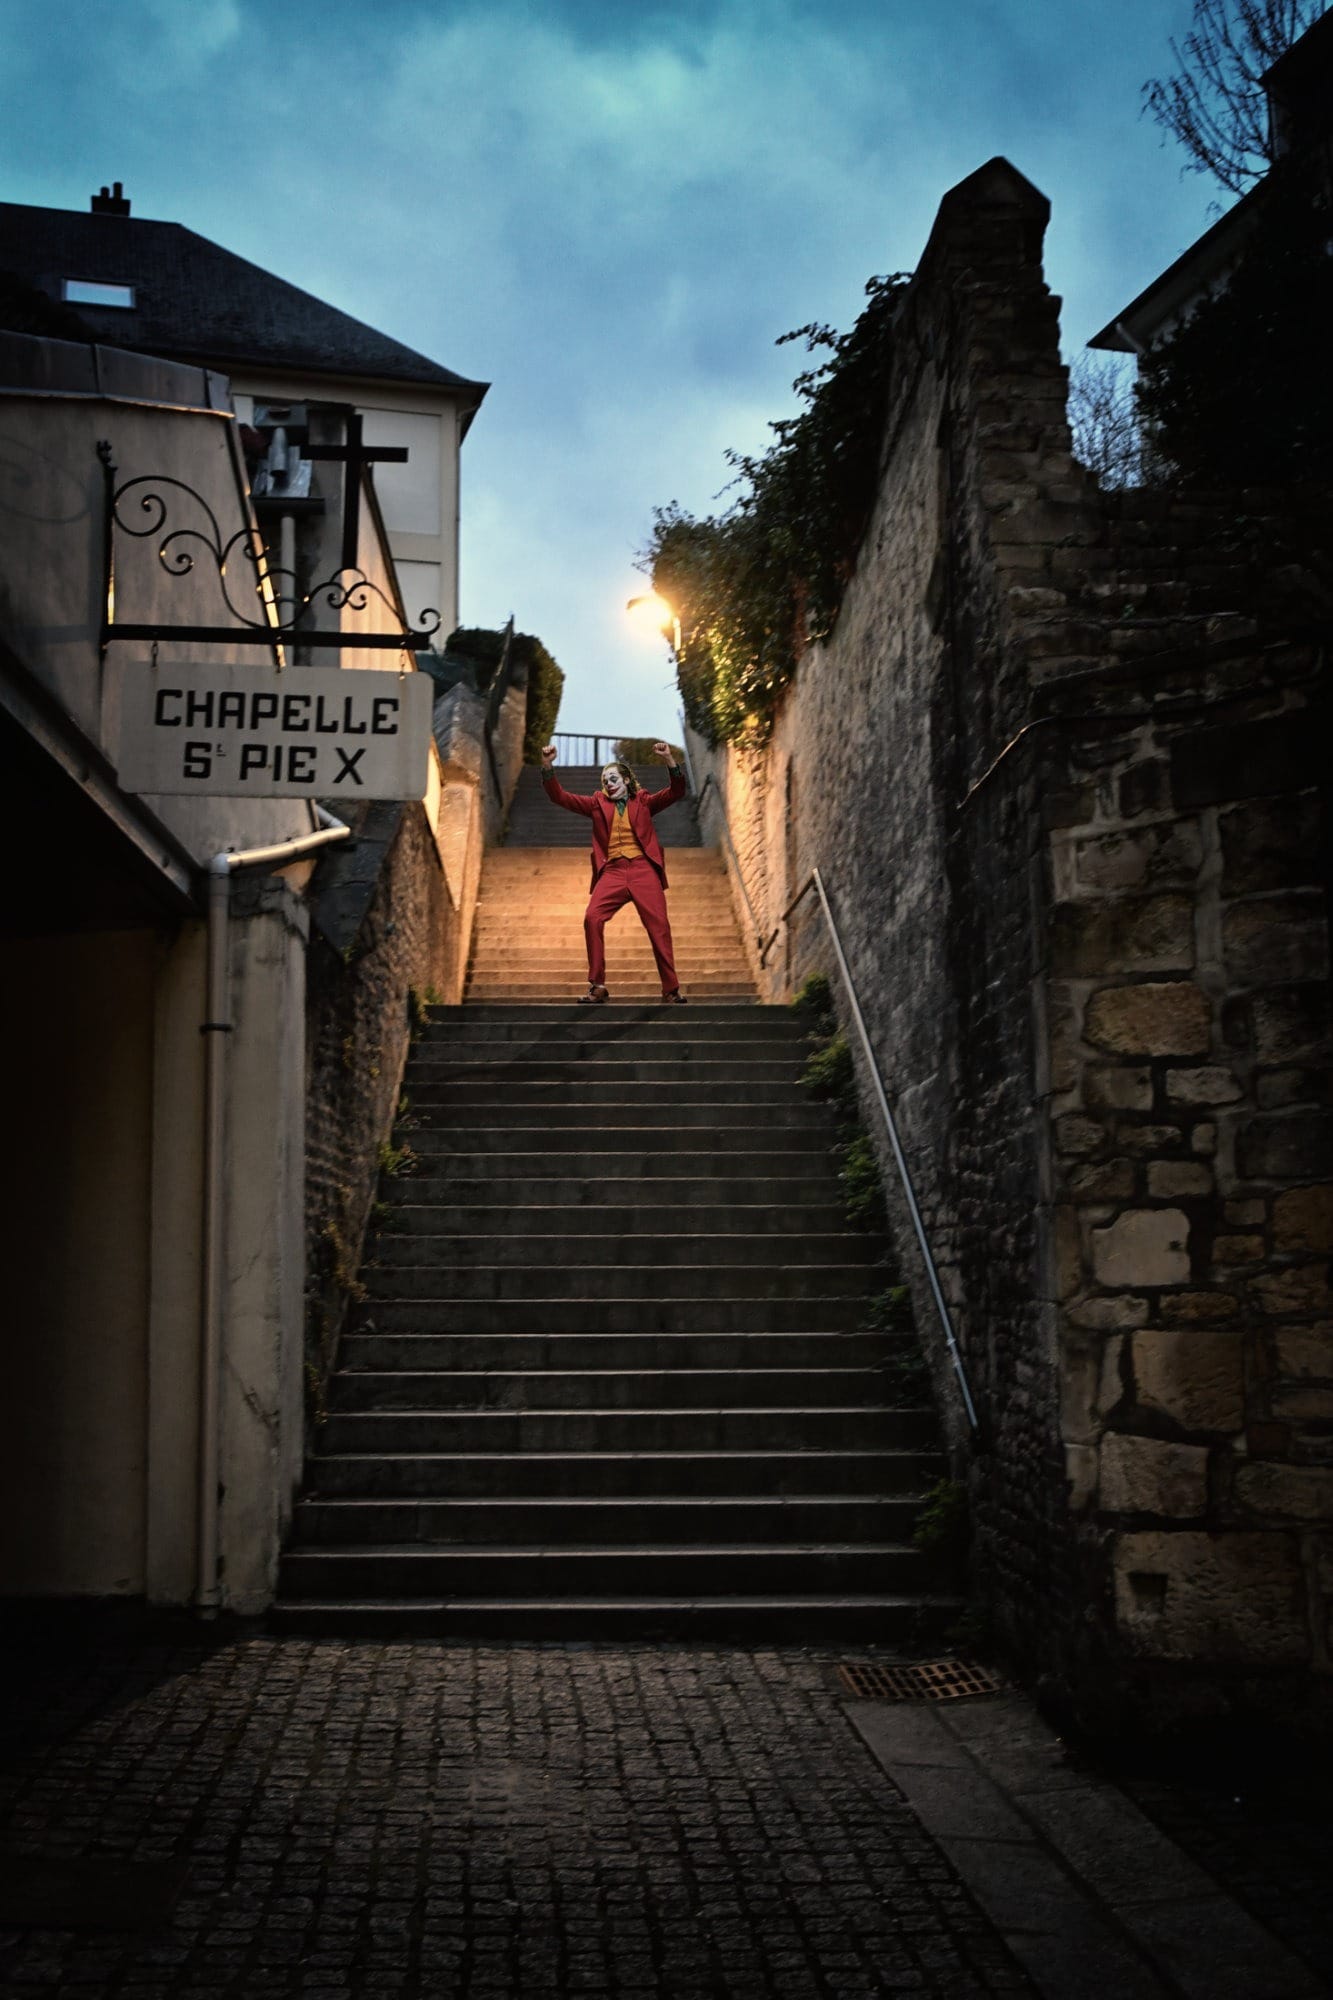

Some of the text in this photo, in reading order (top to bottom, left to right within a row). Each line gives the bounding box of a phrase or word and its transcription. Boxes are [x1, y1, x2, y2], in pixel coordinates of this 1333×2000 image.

[155, 689, 399, 734] CHAPELLE
[239, 744, 316, 783] PIE
[333, 748, 366, 785] X
